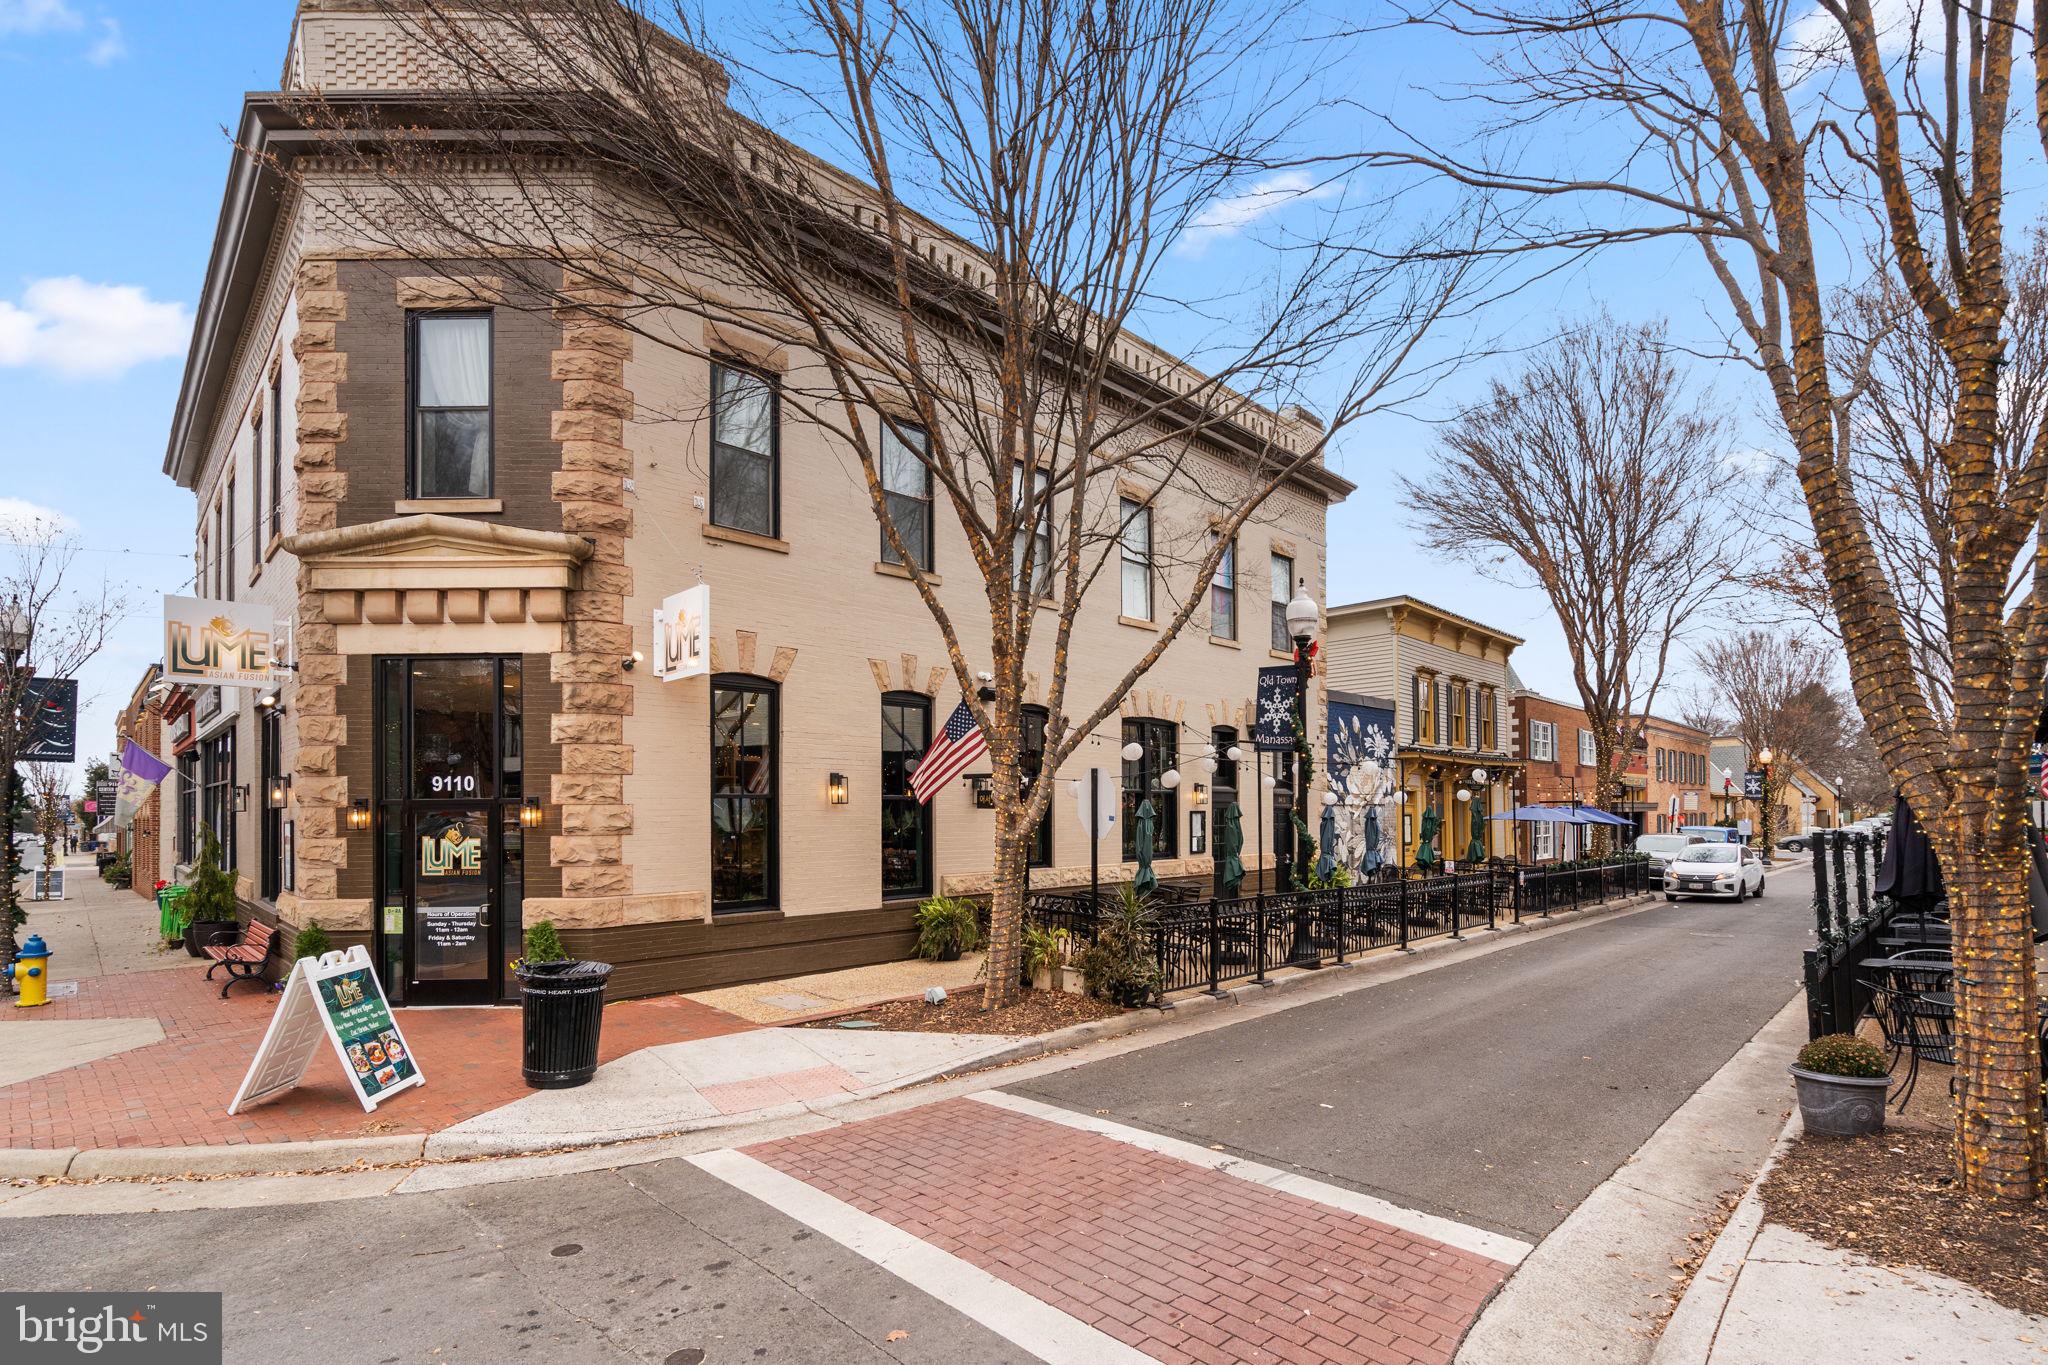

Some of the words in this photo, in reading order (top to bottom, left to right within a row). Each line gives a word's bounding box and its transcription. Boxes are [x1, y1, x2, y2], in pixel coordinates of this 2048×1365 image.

[168, 620, 270, 678] LUME
[665, 615, 702, 673] LUME
[209, 671, 235, 680] ASIAN
[239, 672, 270, 682] FUSION
[1260, 675, 1274, 687] Old
[1276, 675, 1297, 685] Town
[1256, 734, 1296, 745] Manassas
[432, 775, 475, 792] 9110
[422, 836, 481, 876] LUME
[334, 980, 364, 1008] LUME
